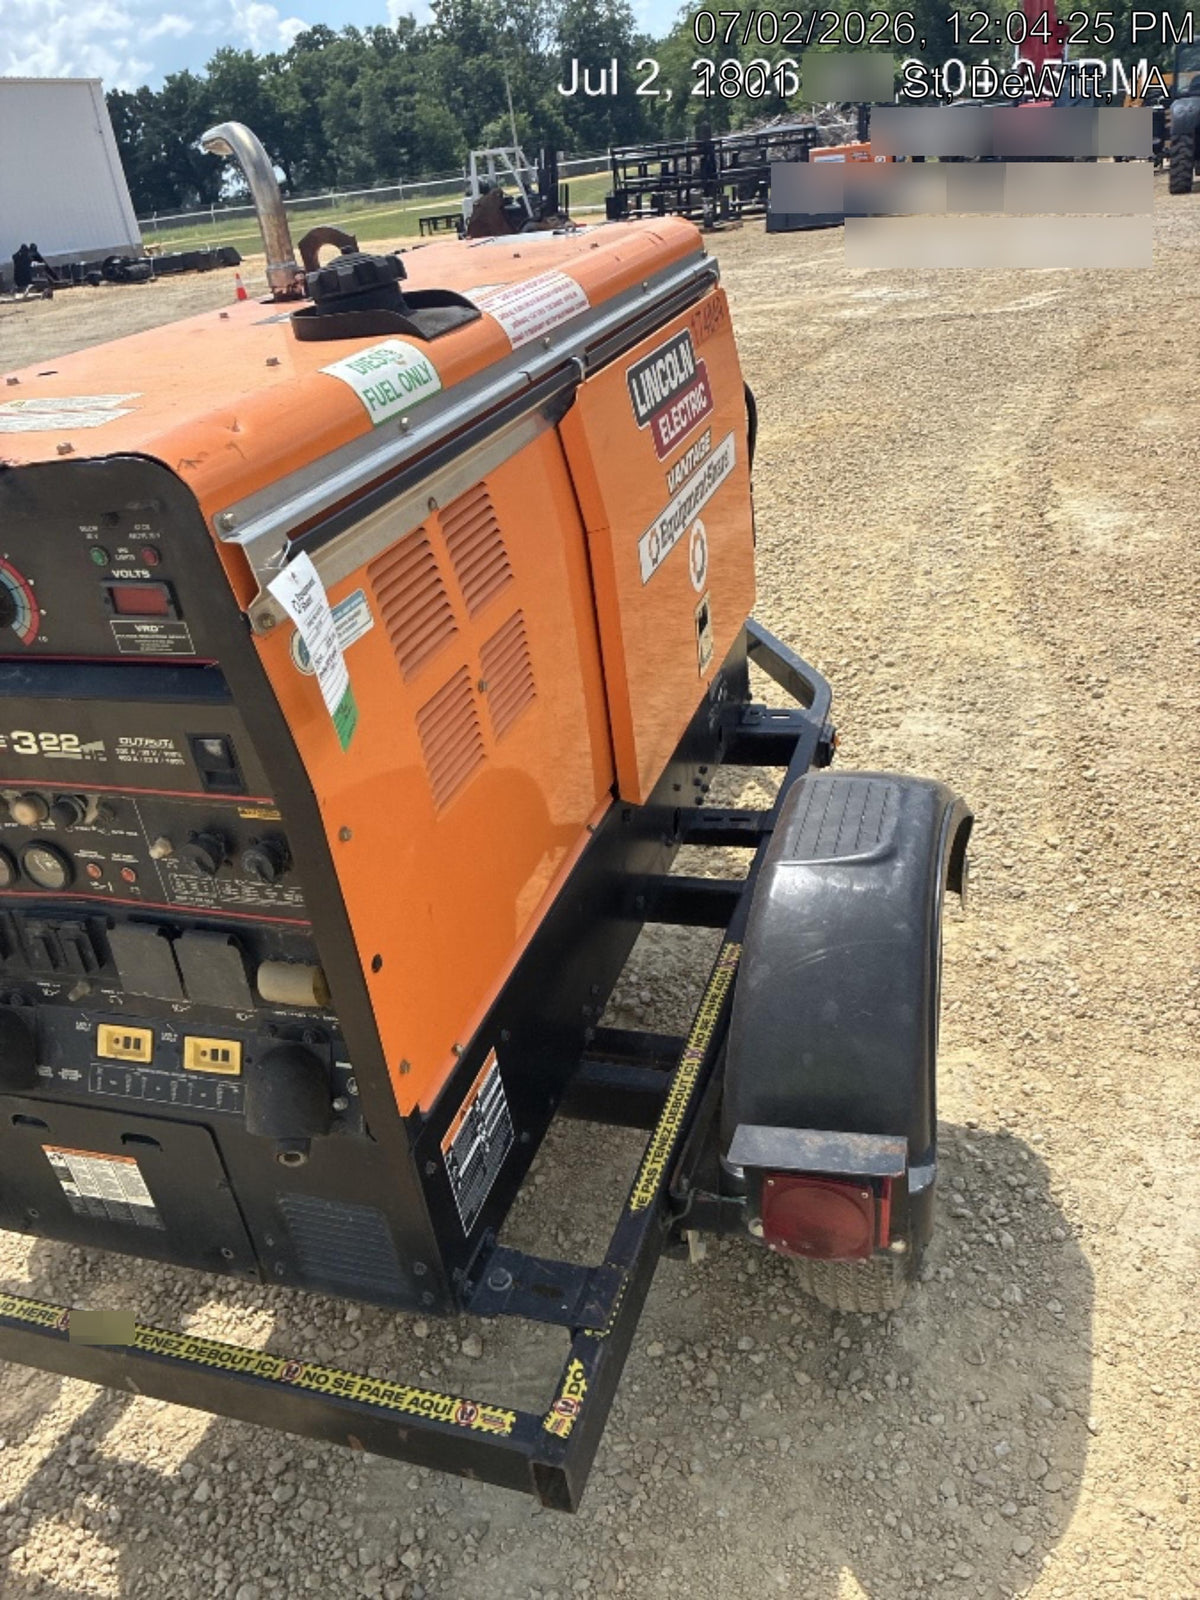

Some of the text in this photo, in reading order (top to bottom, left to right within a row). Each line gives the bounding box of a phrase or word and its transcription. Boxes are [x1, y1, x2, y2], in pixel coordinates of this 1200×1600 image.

[362, 360, 433, 412] FUEL ONLY
[632, 338, 695, 417] LINCOLN
[657, 381, 708, 446] ELECTRIC
[667, 430, 712, 493] VANTAGE
[111, 569, 151, 578] VOLTS
[11, 731, 82, 754] 322
[694, 1033, 705, 1048] NO
[642, 1167, 658, 1193] PAS
[651, 1127, 673, 1165] TENEZ
[666, 1080, 688, 1124] DEBOUT
[684, 1062, 696, 1077] ICI
[19, 1304, 59, 1322] HERE
[135, 1331, 279, 1374] TENEZ DEBOUT ICI
[302, 1369, 330, 1386] NO
[333, 1377, 359, 1392] SE
[358, 1381, 405, 1404] PARE
[567, 1368, 584, 1395] DO
